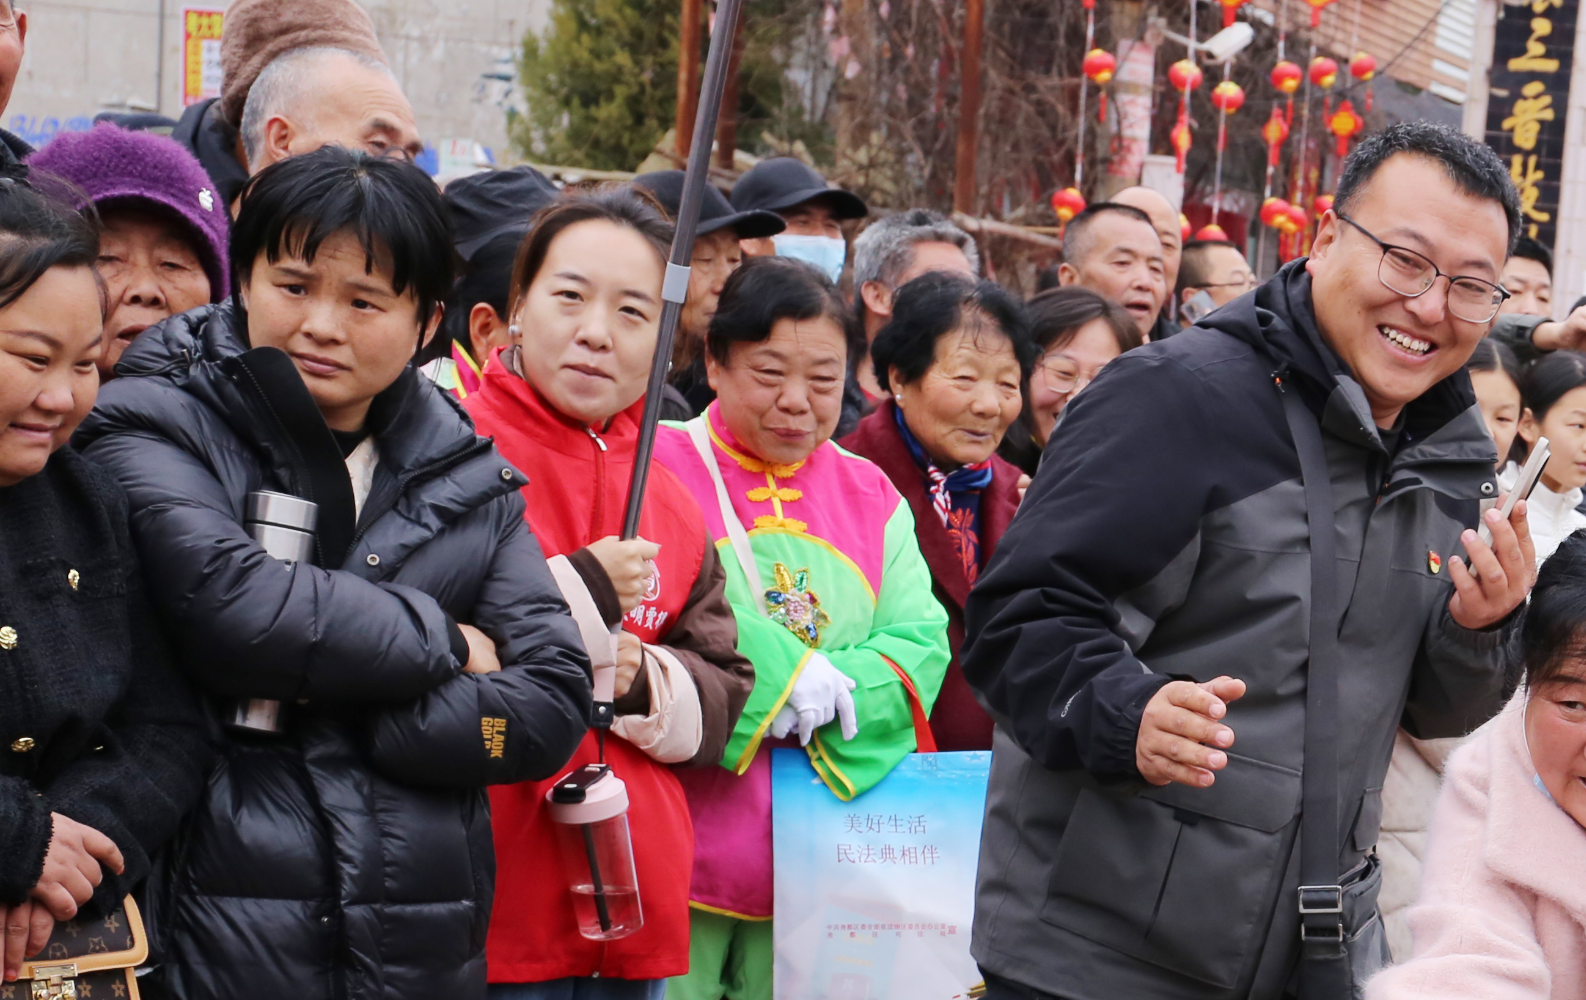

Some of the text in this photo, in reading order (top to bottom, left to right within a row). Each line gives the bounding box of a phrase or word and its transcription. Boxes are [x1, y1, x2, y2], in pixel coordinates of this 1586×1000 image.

[843, 813, 928, 835] 美好生活
[836, 843, 940, 866] 民法典相伴
